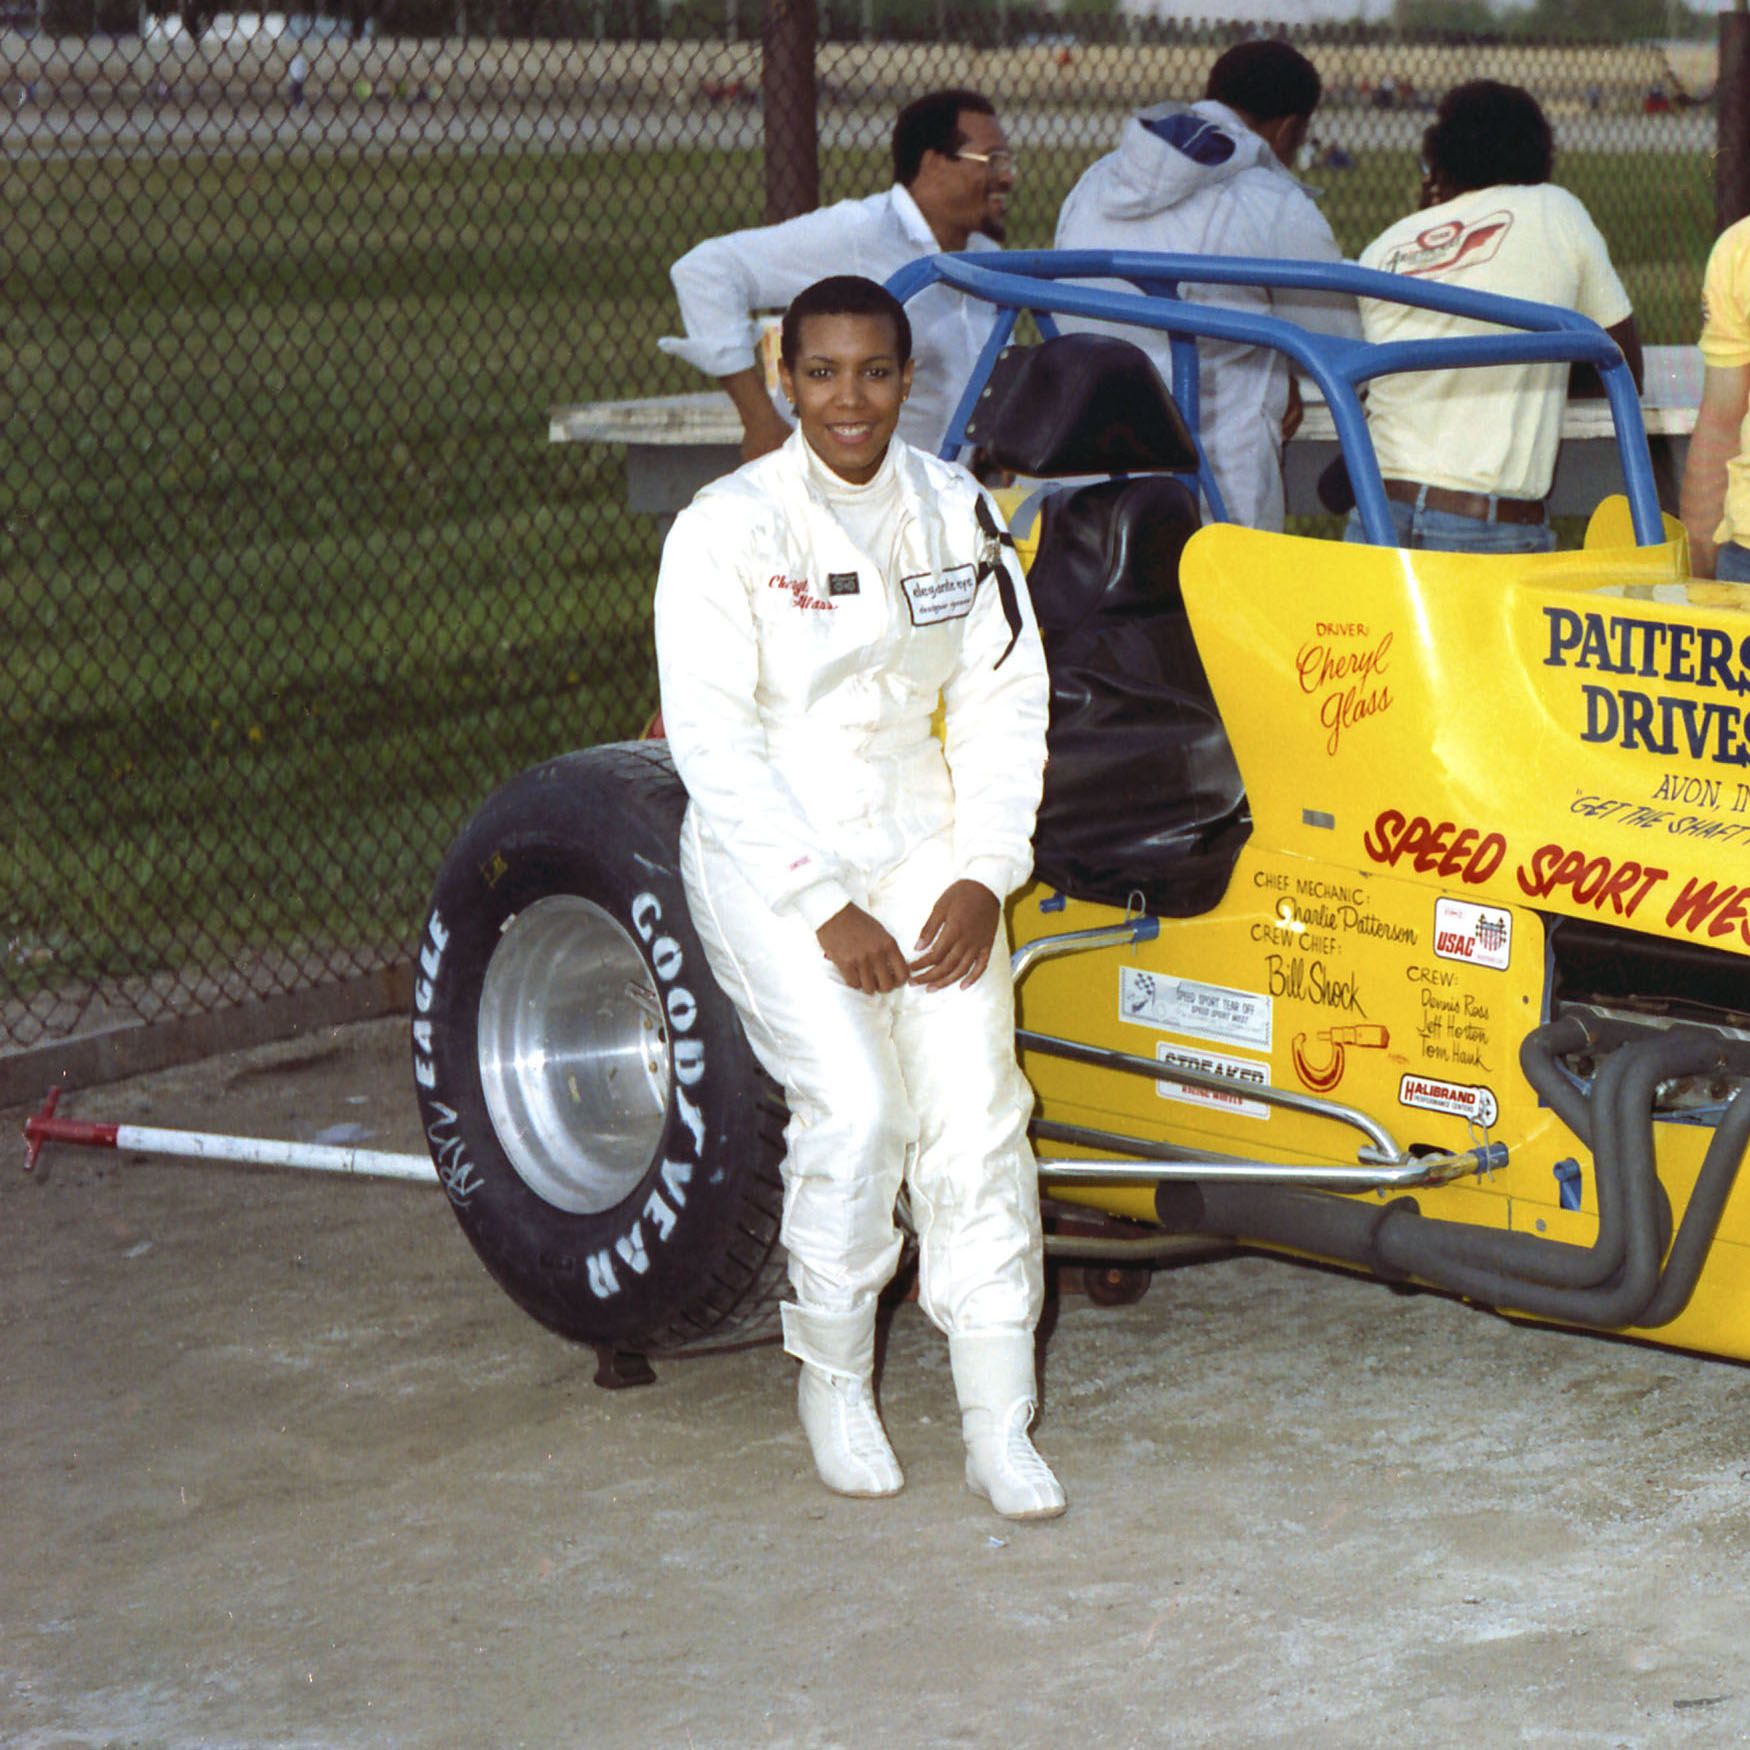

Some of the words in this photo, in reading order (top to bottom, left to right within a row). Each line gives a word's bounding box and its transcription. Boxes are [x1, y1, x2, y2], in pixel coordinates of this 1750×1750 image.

[1295, 631, 1394, 694] Cheryl
[1320, 685, 1394, 756] Glass
[1653, 774, 1722, 812] AVON,
[1618, 805, 1664, 829] THE
[1668, 815, 1747, 842] SHAFT
[1253, 871, 1290, 891] CHIEF
[1364, 809, 1506, 885] SPEED
[1517, 844, 1668, 919] SPORT
[1250, 922, 1293, 948] CREW
[1275, 896, 1337, 930] Charlie
[1336, 905, 1418, 947] Patterson
[1437, 931, 1475, 957] USAC
[412, 908, 450, 1090] EAGLE
[1264, 954, 1308, 1001] Bill
[1309, 961, 1368, 1019] Shock
[1419, 1033, 1449, 1062] Tom
[1447, 1015, 1489, 1044] Horton
[1404, 1080, 1476, 1105] HALIBRAND
